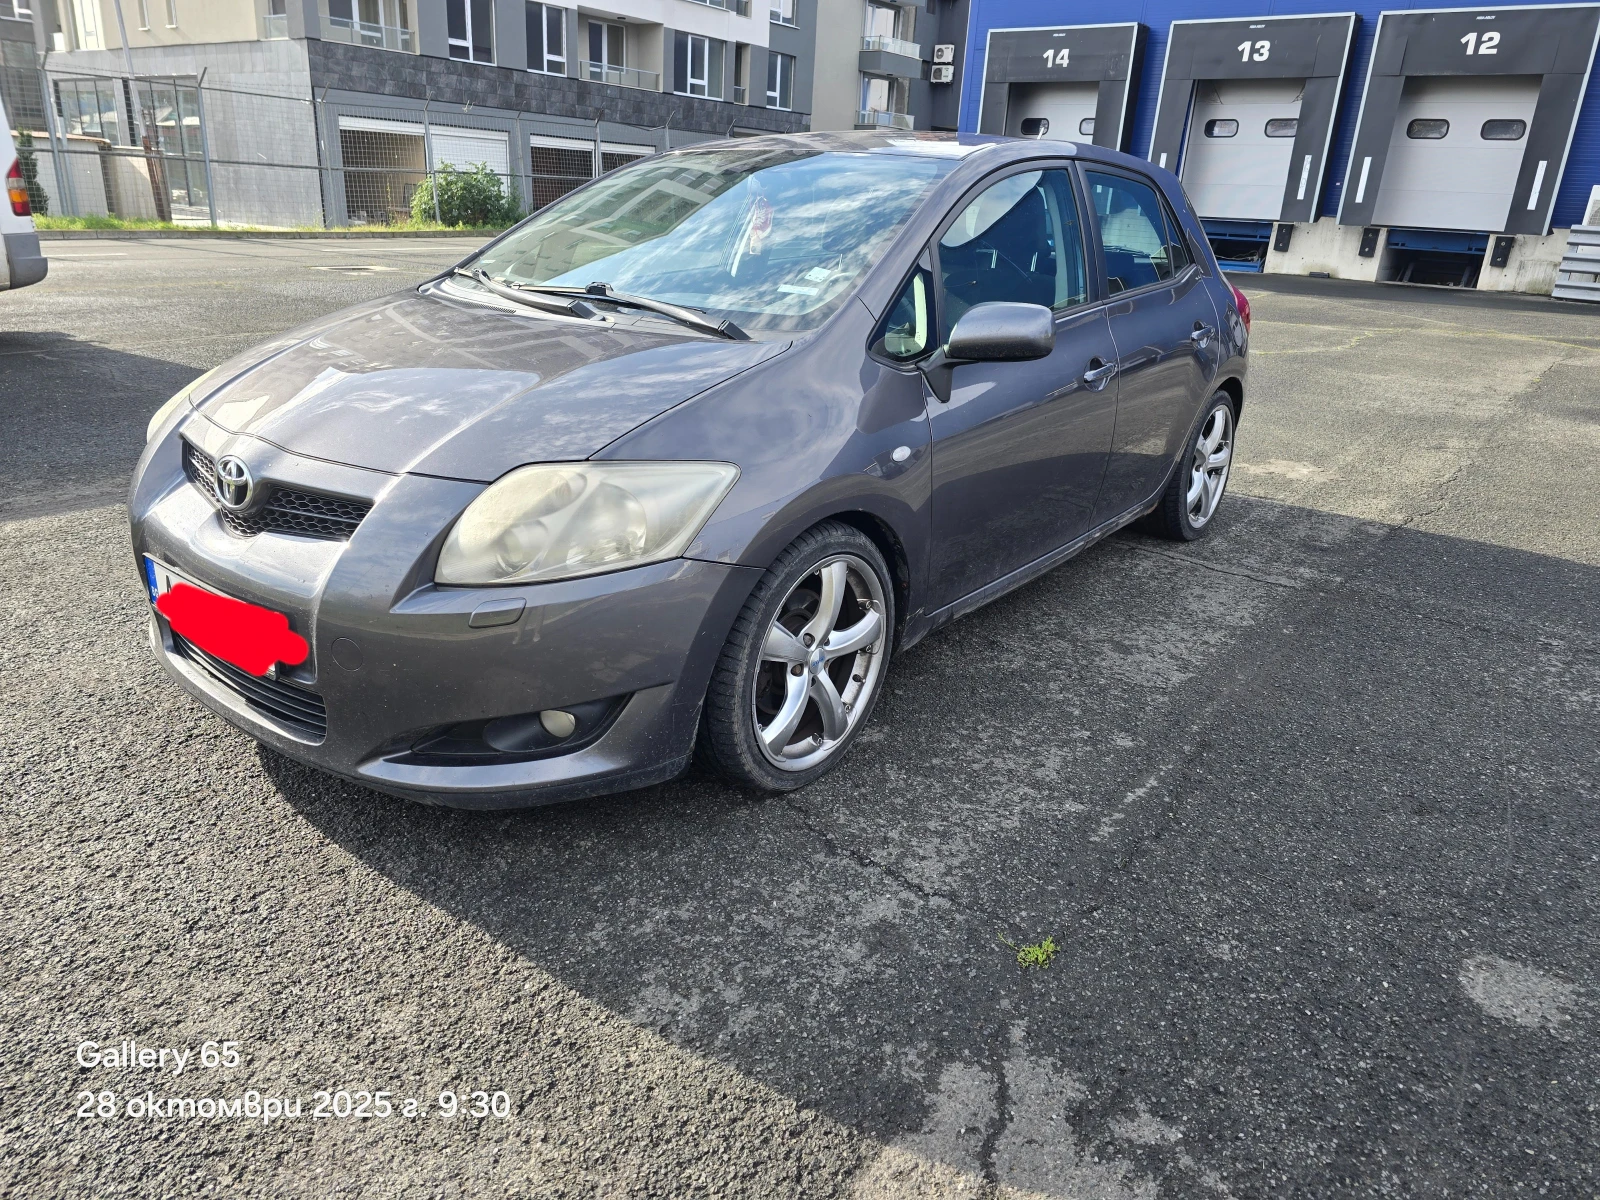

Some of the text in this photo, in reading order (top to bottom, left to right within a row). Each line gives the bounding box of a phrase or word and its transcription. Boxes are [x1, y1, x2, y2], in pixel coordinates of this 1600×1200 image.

[1237, 40, 1271, 62] 13
[1460, 31, 1501, 55] 12
[1042, 48, 1070, 68] 14
